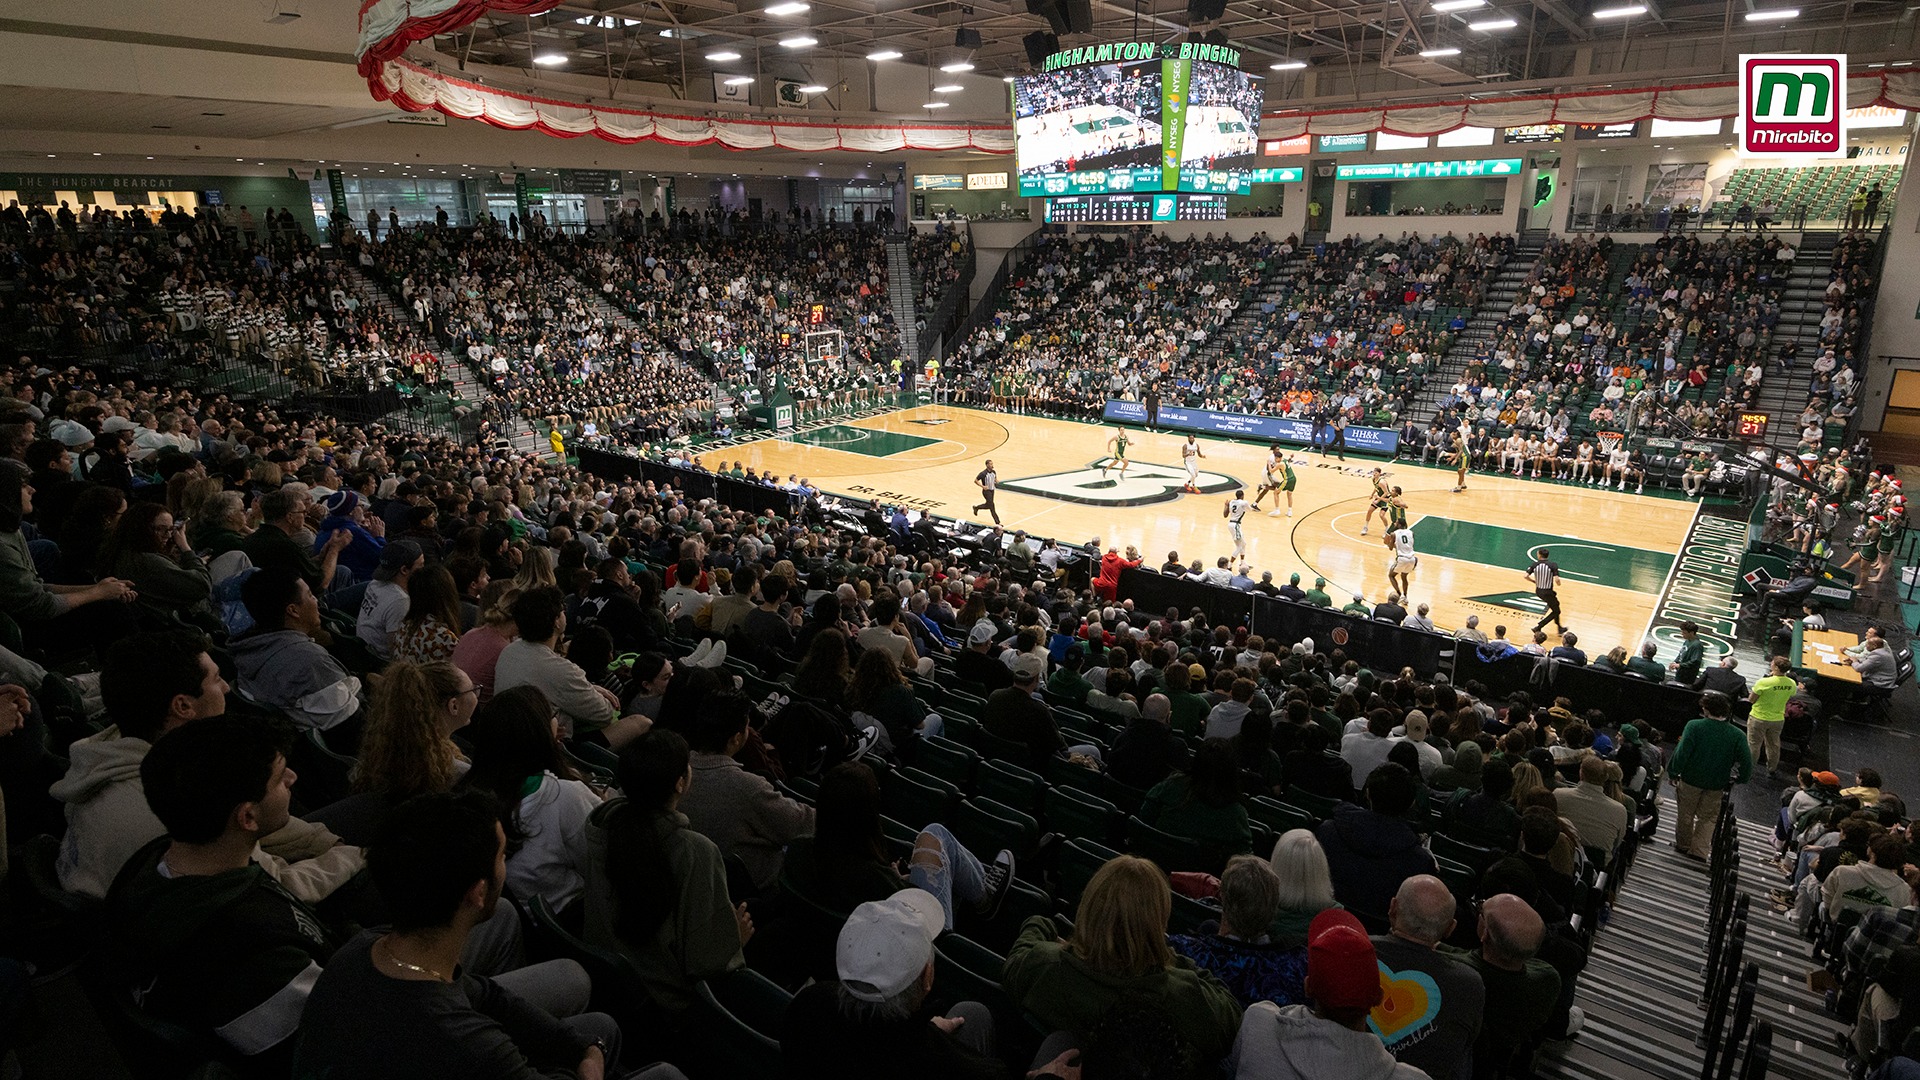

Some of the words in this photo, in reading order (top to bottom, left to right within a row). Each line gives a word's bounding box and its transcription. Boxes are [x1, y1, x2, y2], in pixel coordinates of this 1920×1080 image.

[1045, 42, 1155, 72] BINGHAMTON
[1172, 61, 1181, 93] NYSEG
[1846, 106, 1897, 118] UNKIN
[1169, 118, 1178, 148] NYSEG
[19, 177, 42, 187] THE
[52, 177, 105, 188] HUNGRY
[113, 178, 174, 188] BEARCAT
[1071, 172, 1105, 186] 14:59
[1112, 175, 1130, 190] 47
[1047, 179, 1065, 192] 53
[811, 311, 823, 323] 27
[1120, 403, 1143, 412] HH&K
[1742, 415, 1767, 423] 14:59
[1352, 429, 1379, 440] HH&K
[1741, 423, 1759, 434] 27
[1734, 453, 1762, 468] Schelde
[846, 485, 876, 494] DR.
[876, 491, 947, 508] BAILEE
[1232, 505, 1238, 513] 2
[1401, 535, 1408, 544] 0
[1651, 514, 1749, 658] BINGHAMTON
